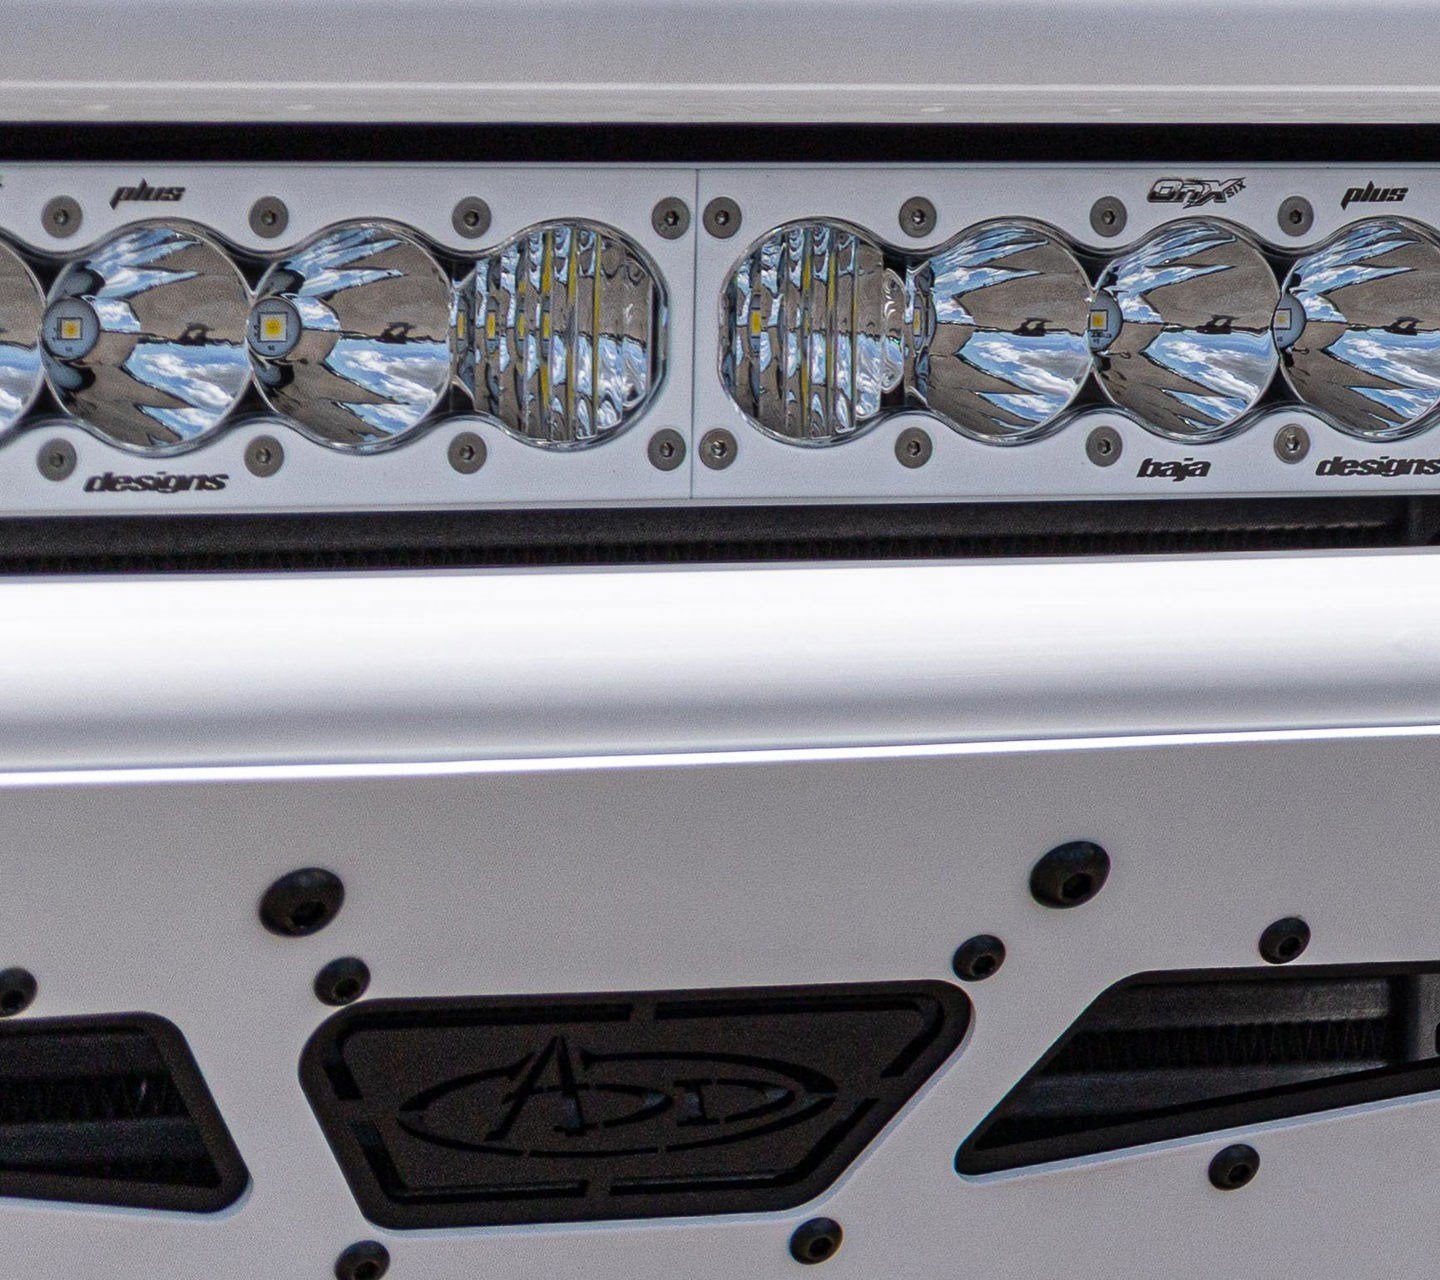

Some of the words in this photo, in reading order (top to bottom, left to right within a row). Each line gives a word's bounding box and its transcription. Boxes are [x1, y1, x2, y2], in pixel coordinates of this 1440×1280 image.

[109, 178, 187, 211] plus
[1340, 180, 1409, 211] plus
[83, 471, 230, 493] designs
[1136, 457, 1212, 482] baja
